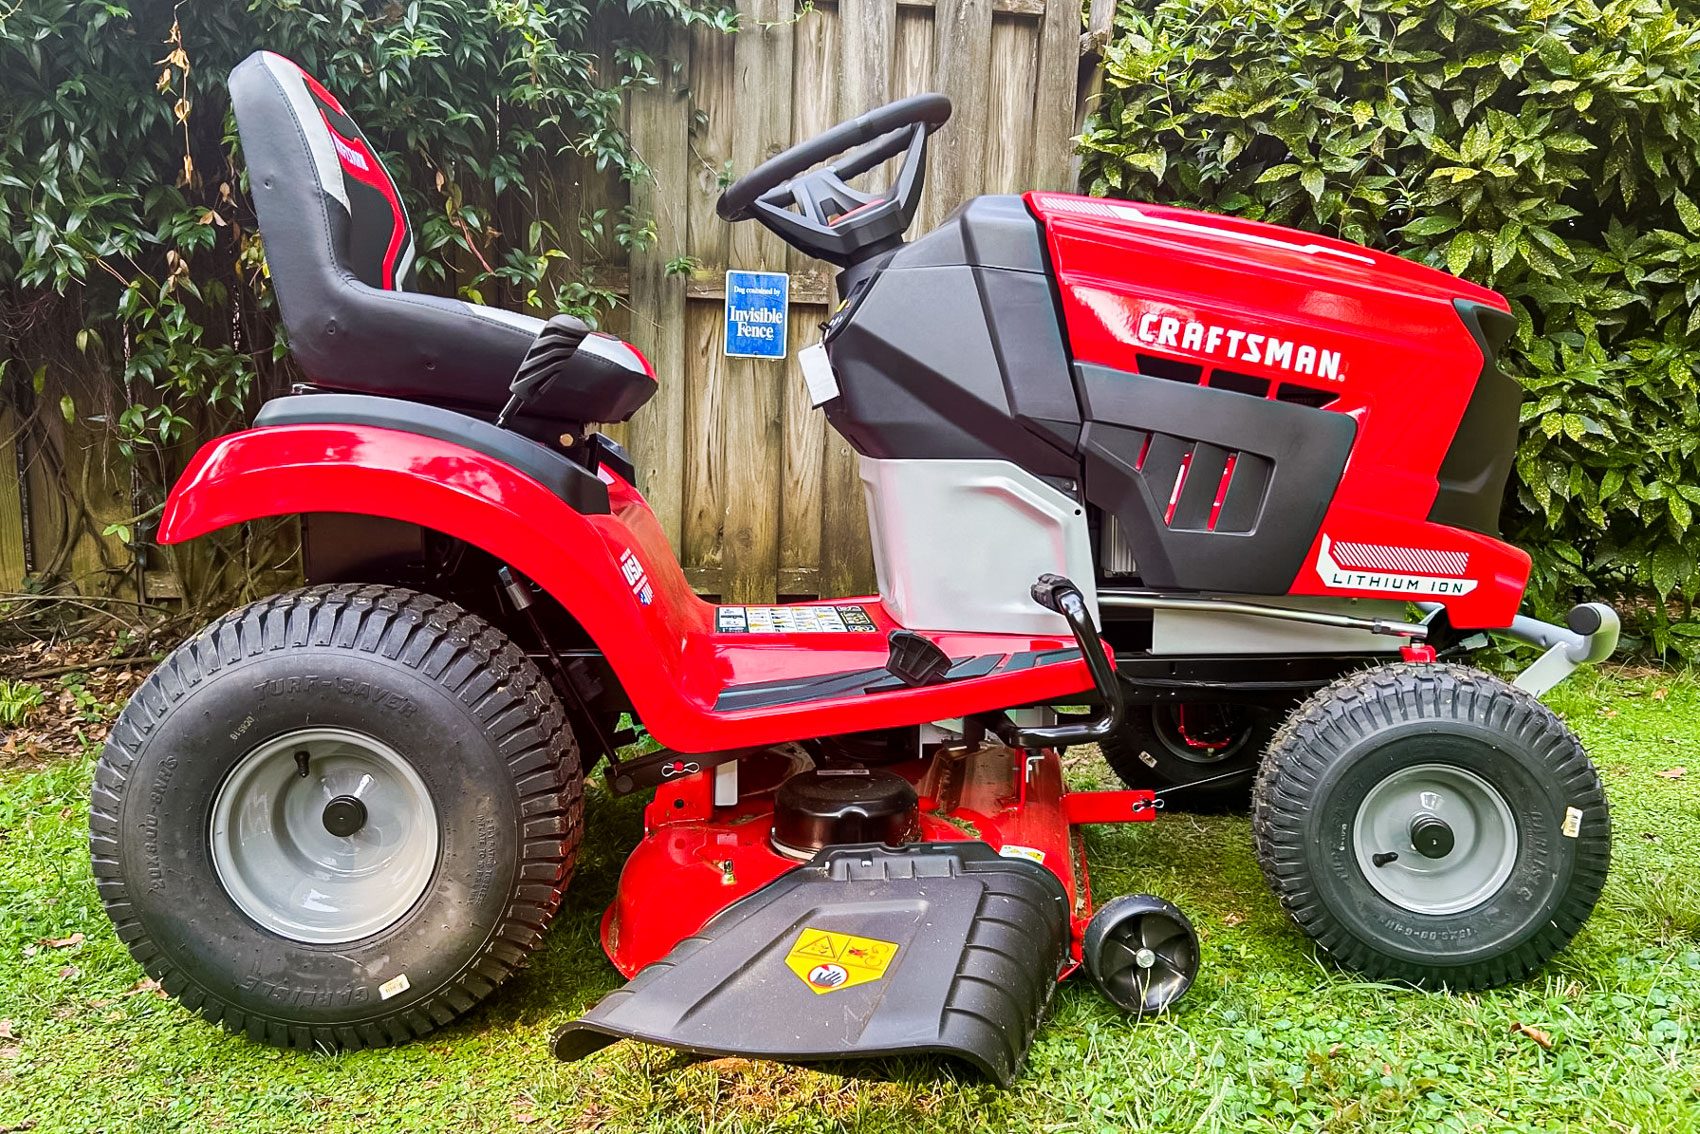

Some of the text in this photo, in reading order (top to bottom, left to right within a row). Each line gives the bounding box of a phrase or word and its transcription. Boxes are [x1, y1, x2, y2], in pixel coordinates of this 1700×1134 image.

[729, 305, 783, 323] Invisible
[737, 321, 774, 340] Fence
[1138, 312, 1344, 382] CRAFTSMAN
[1332, 573, 1463, 593] LITHIUM ION
